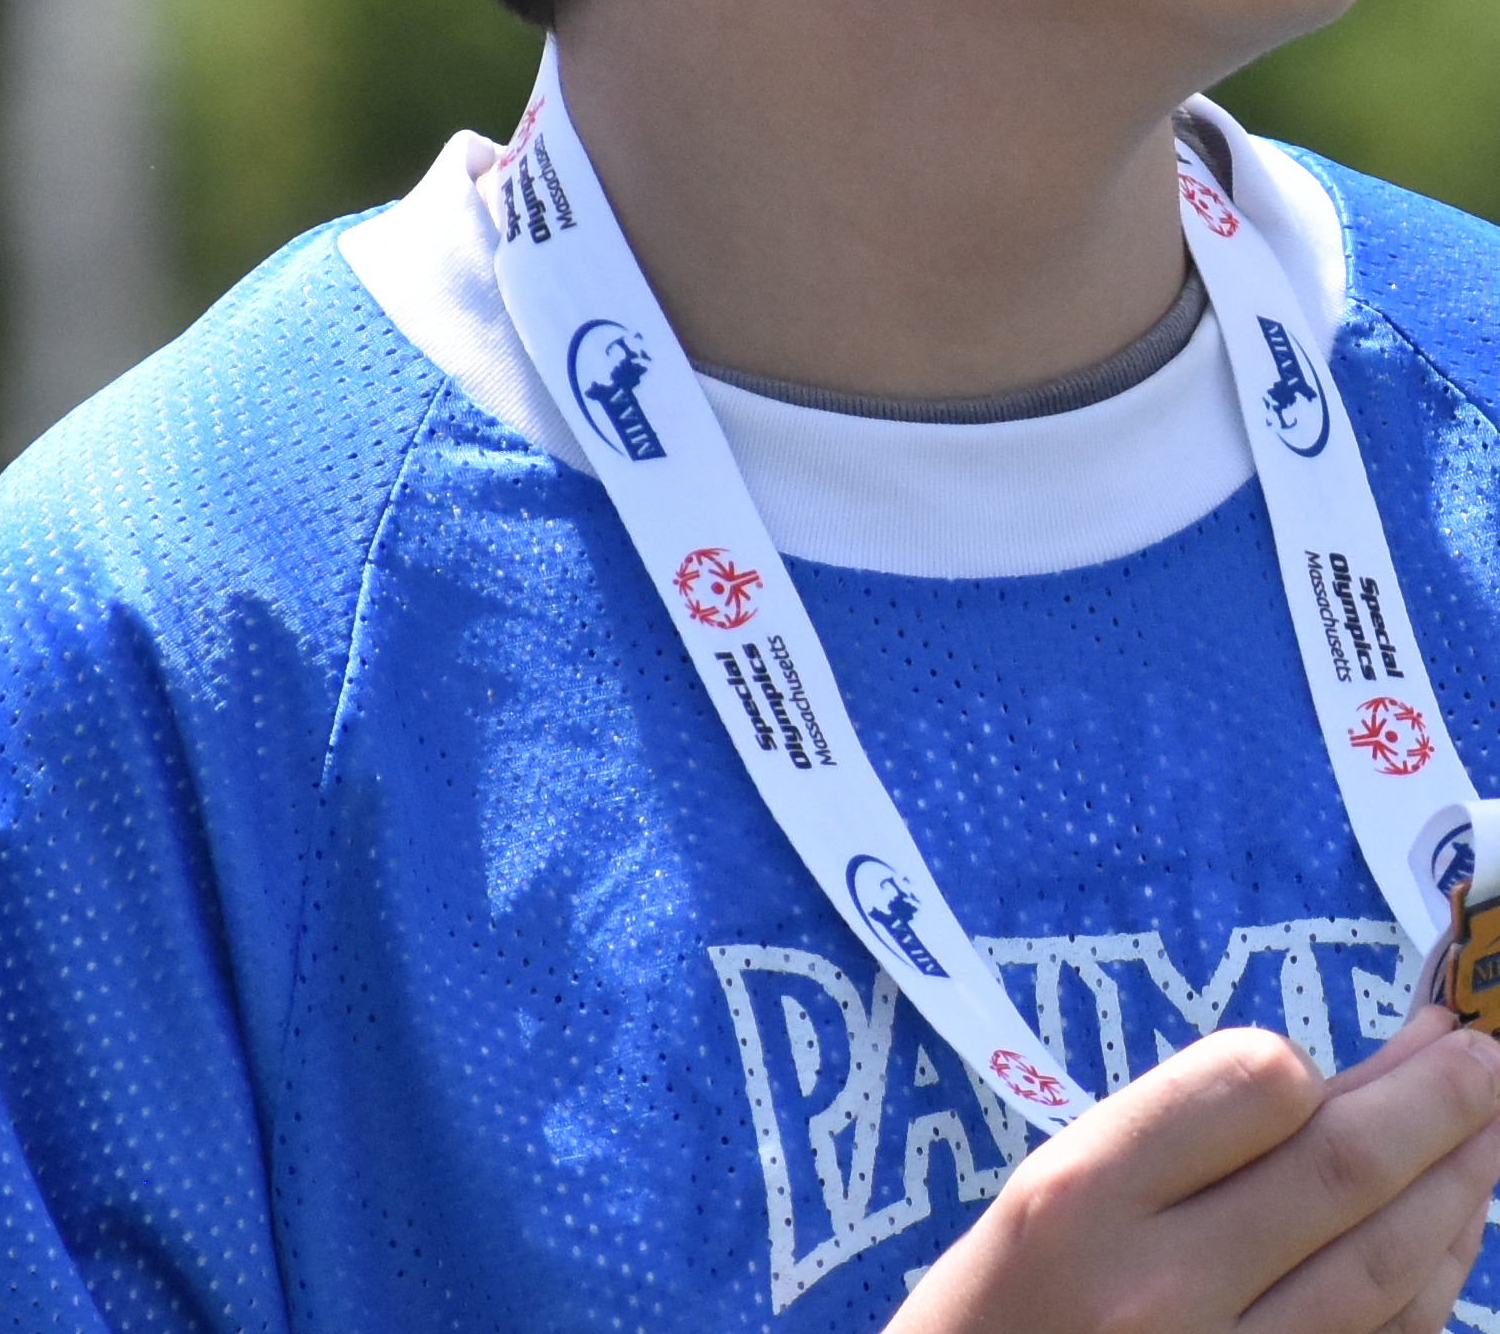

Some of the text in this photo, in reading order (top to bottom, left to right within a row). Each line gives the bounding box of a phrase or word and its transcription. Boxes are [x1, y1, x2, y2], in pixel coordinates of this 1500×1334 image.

[1265, 323, 1299, 386] MIAA
[609, 387, 656, 457] MIAA
[1304, 550, 1352, 683] Massachusetts
[1329, 552, 1377, 681] Olympics
[1359, 576, 1404, 679] Special
[714, 651, 778, 751] Special
[742, 642, 813, 769] Olympics
[766, 635, 837, 766] Massachusetts
